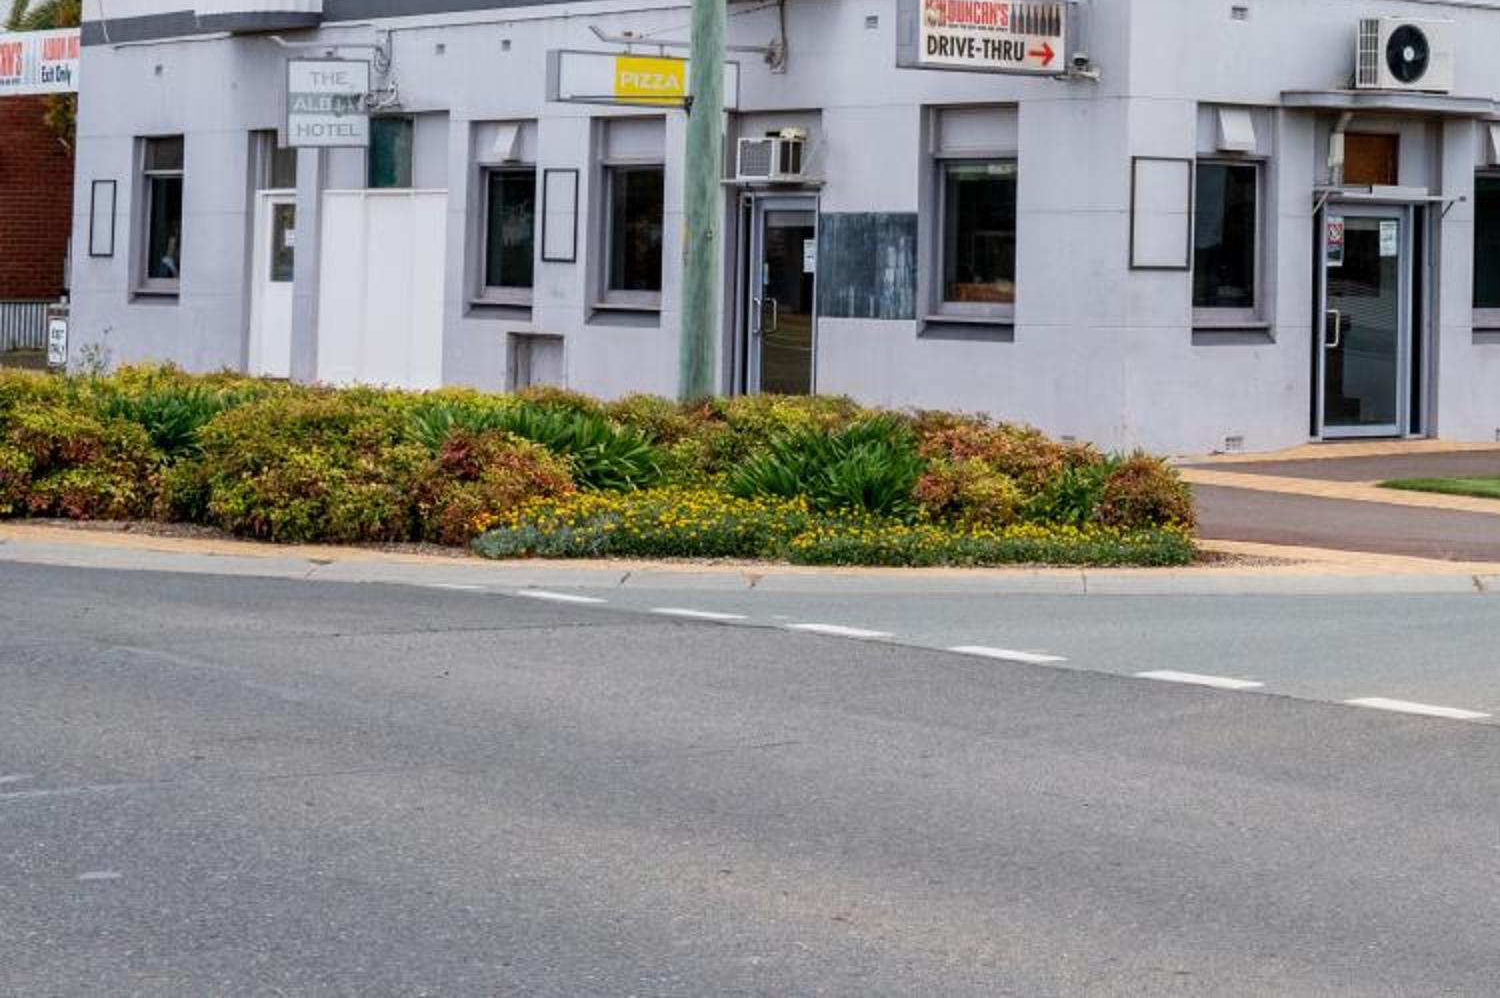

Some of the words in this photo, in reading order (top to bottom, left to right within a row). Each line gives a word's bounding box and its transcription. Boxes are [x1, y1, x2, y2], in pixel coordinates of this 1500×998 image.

[926, 34, 1026, 63] DRIVE-THRU
[55, 63, 71, 88] Only
[309, 71, 349, 86] THE
[620, 70, 681, 91] PIZZA
[293, 96, 362, 113] ALB
[297, 122, 362, 138] HOTEL
